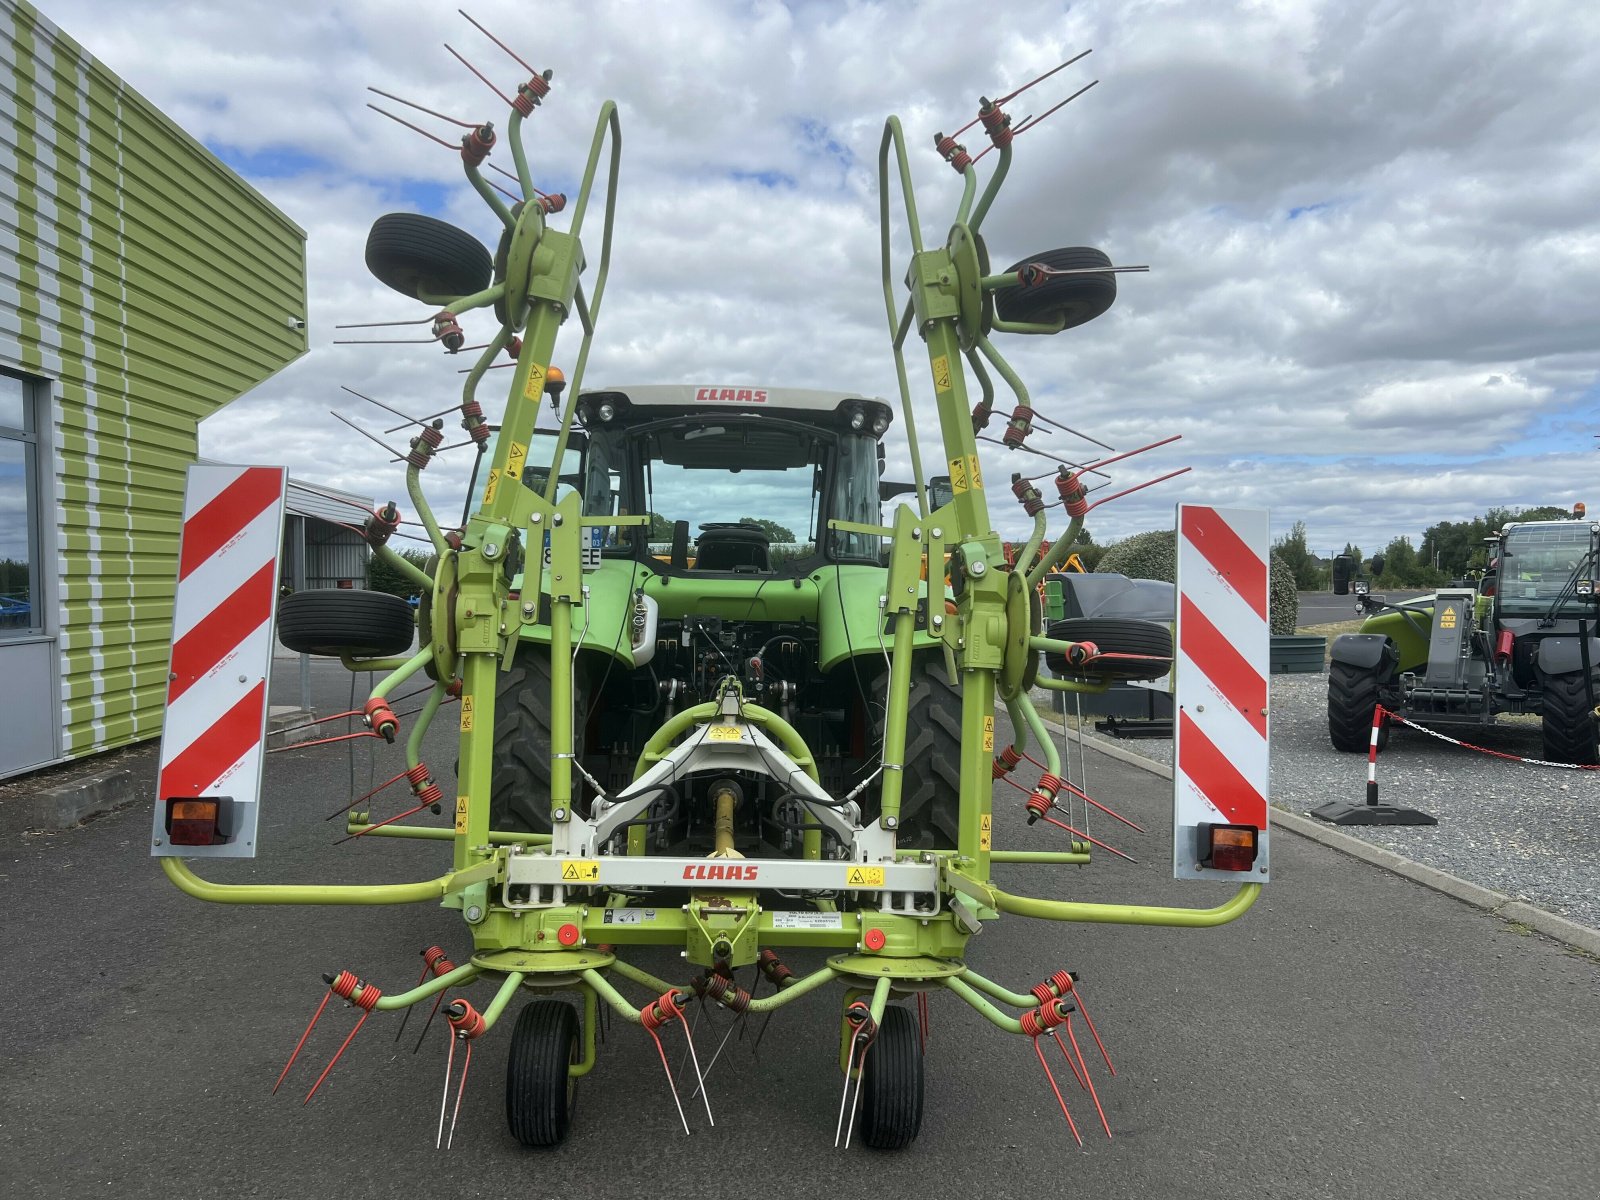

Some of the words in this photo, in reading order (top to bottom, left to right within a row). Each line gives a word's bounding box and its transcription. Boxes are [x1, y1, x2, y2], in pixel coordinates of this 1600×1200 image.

[696, 388, 767, 403] CLAAS
[592, 539, 600, 547] 03
[682, 865, 759, 880] CLAAS
